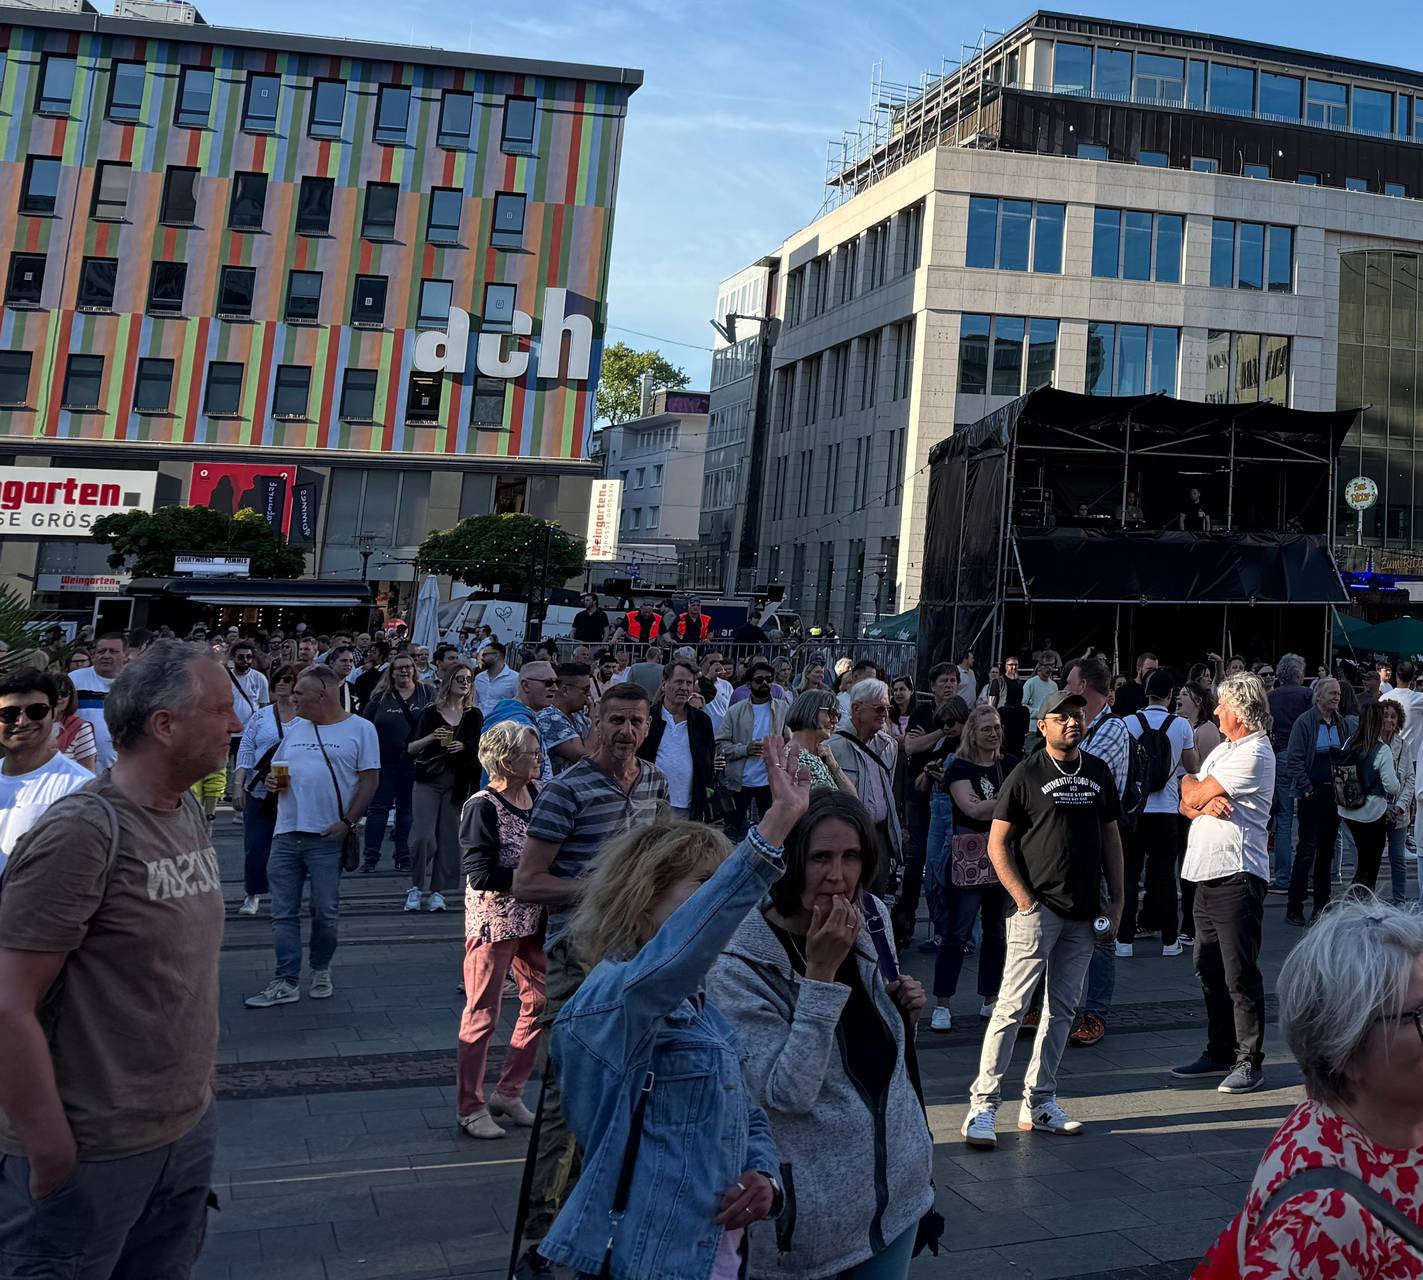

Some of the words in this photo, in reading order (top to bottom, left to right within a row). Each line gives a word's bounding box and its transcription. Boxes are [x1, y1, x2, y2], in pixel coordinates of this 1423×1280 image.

[0, 478, 121, 510] garten
[61, 575, 116, 586] Weingarten
[1040, 776, 1073, 795] AUTHENTIC
